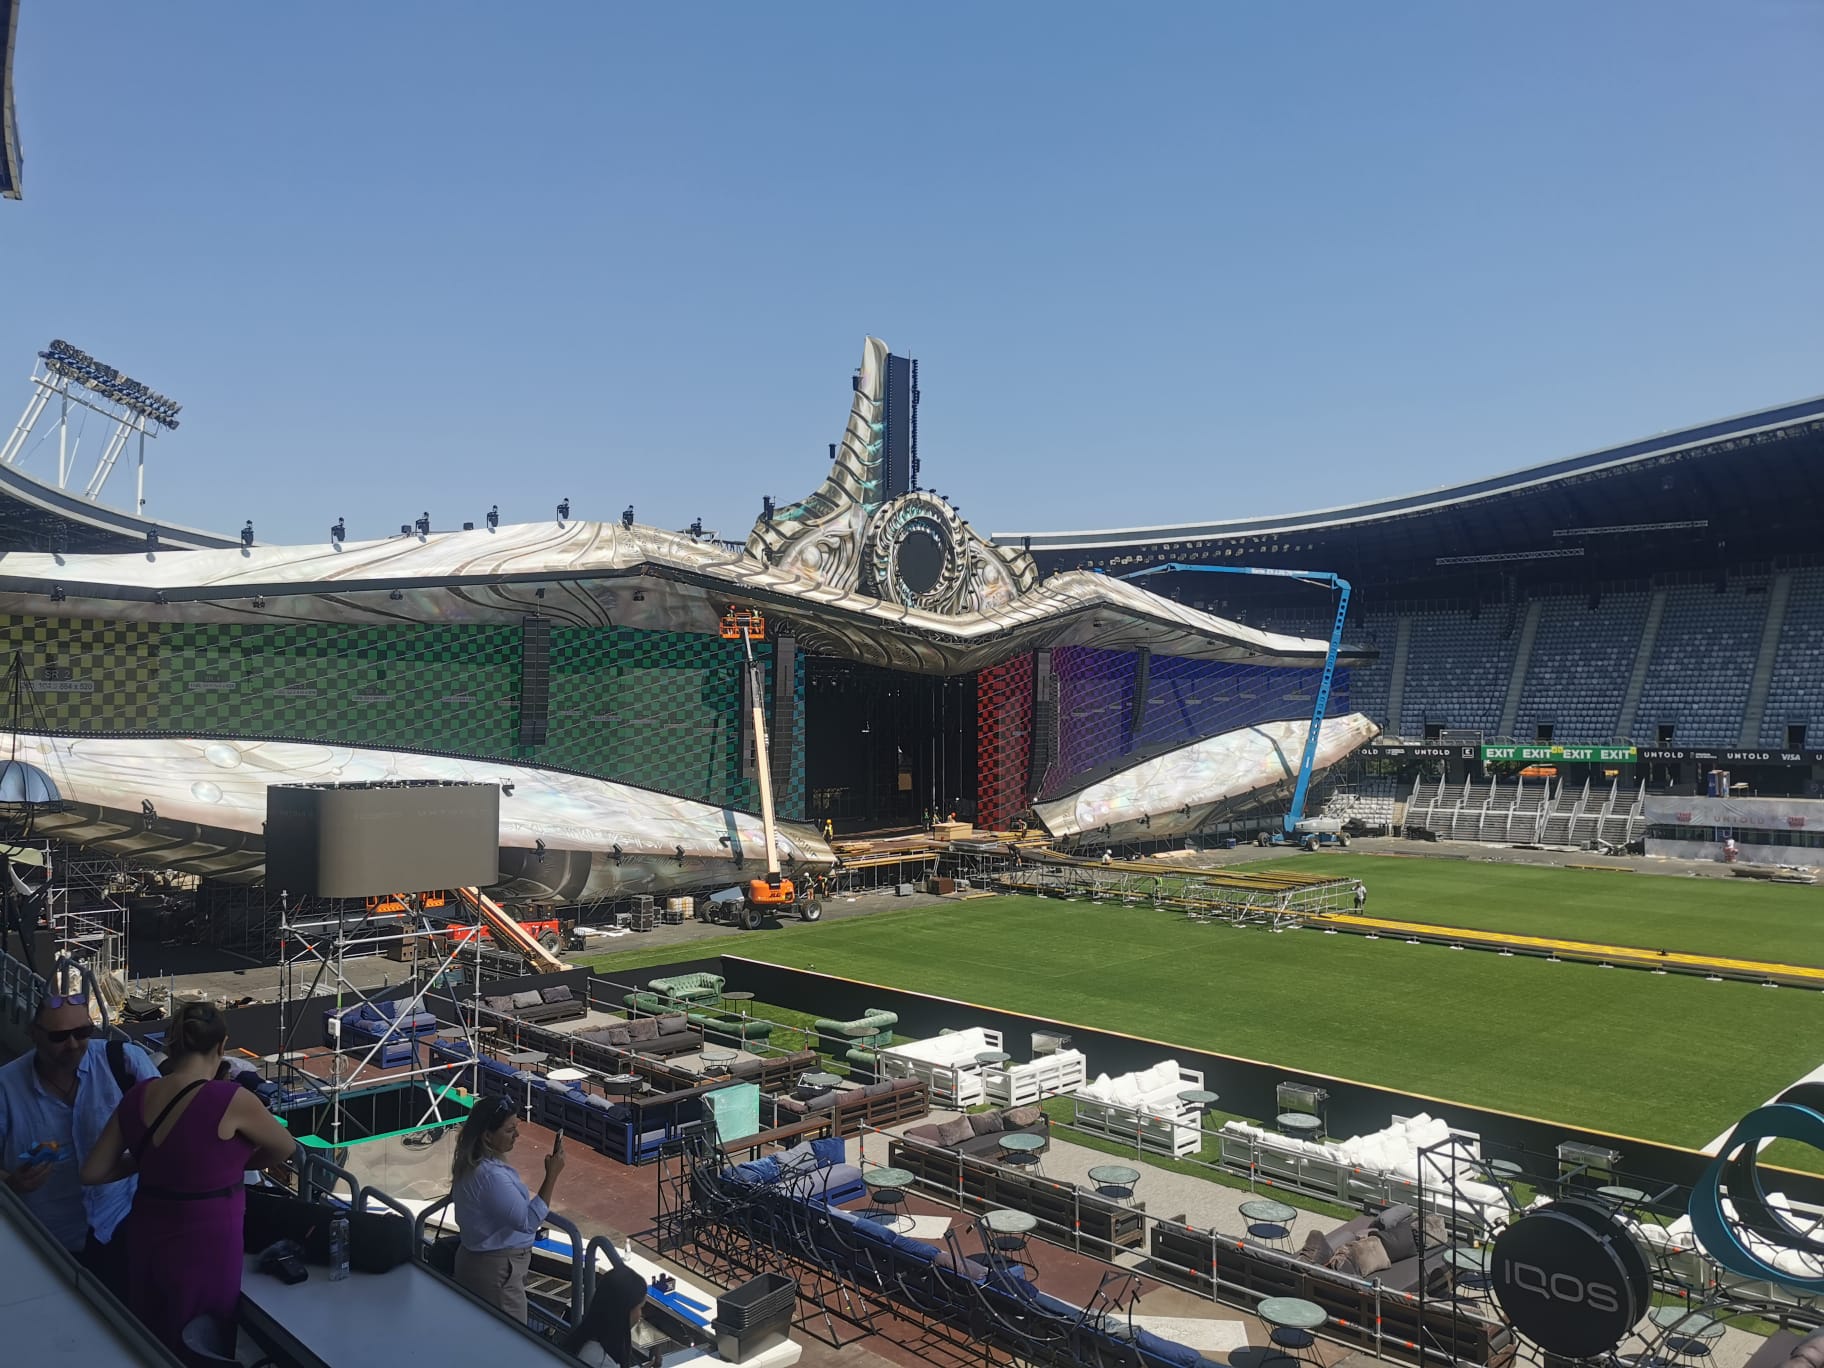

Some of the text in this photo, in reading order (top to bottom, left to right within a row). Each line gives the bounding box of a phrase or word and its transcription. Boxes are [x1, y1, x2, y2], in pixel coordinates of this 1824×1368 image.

[1486, 749, 1630, 759] EXIT EXIT EXIT EXIT
[1781, 753, 1801, 761] VISA
[1504, 1259, 1619, 1312] IQOS
